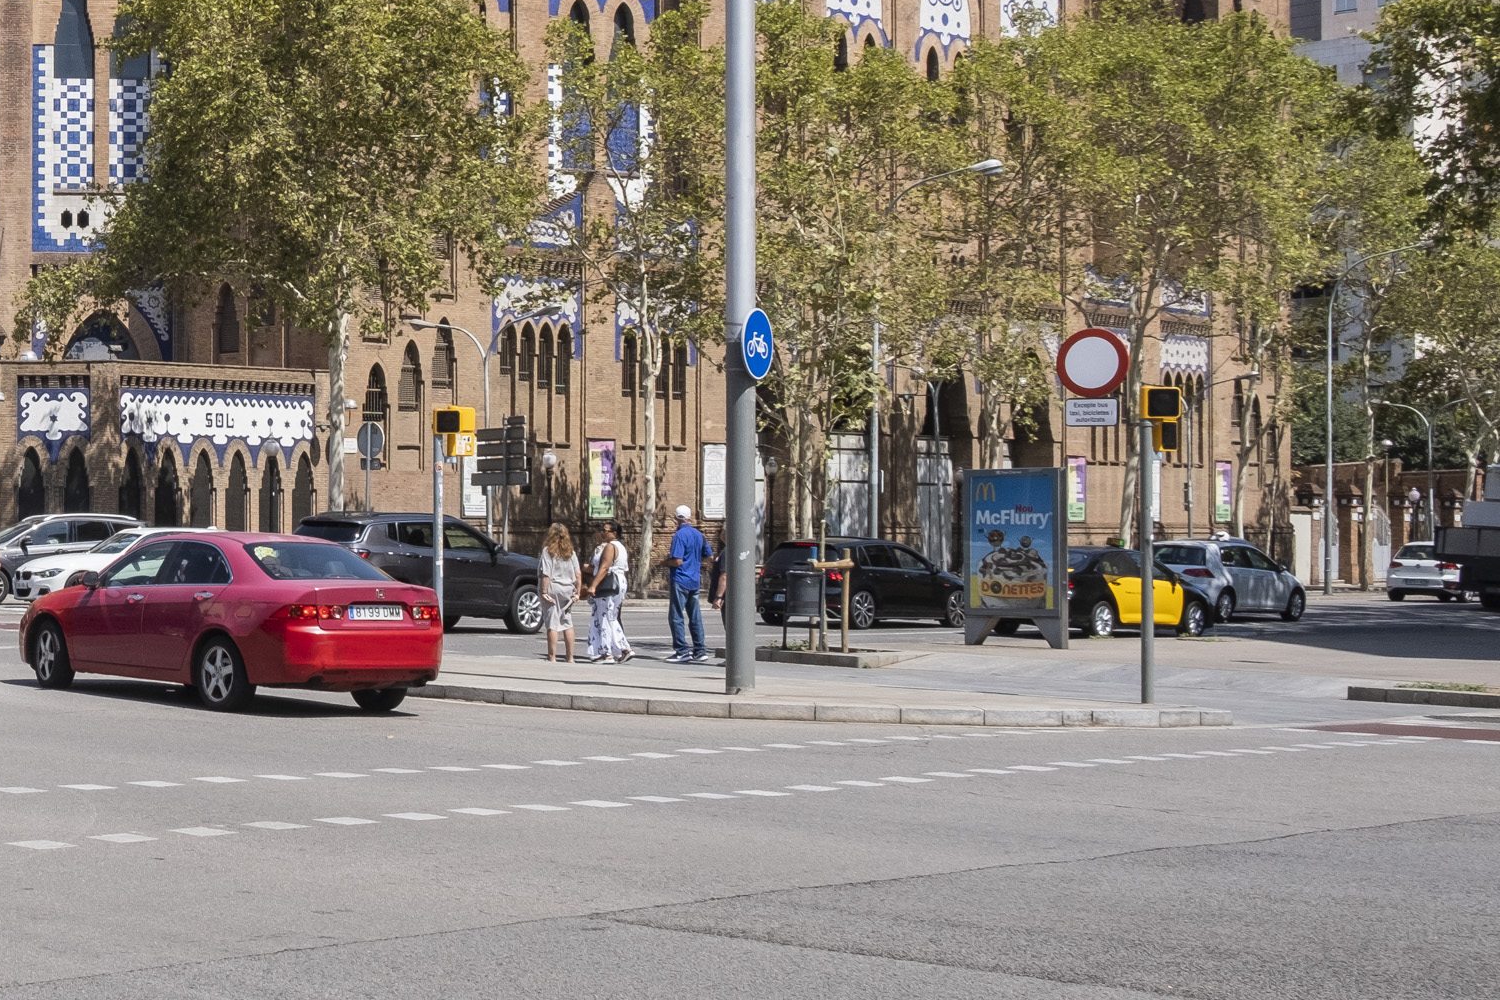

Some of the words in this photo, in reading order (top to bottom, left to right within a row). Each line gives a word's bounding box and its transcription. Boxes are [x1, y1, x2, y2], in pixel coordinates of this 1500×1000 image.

[205, 412, 235, 428] SOL
[1015, 504, 1033, 512] Nou
[976, 510, 1049, 529] McFlurry
[356, 606, 381, 618] 8199
[383, 606, 401, 618] DMM
